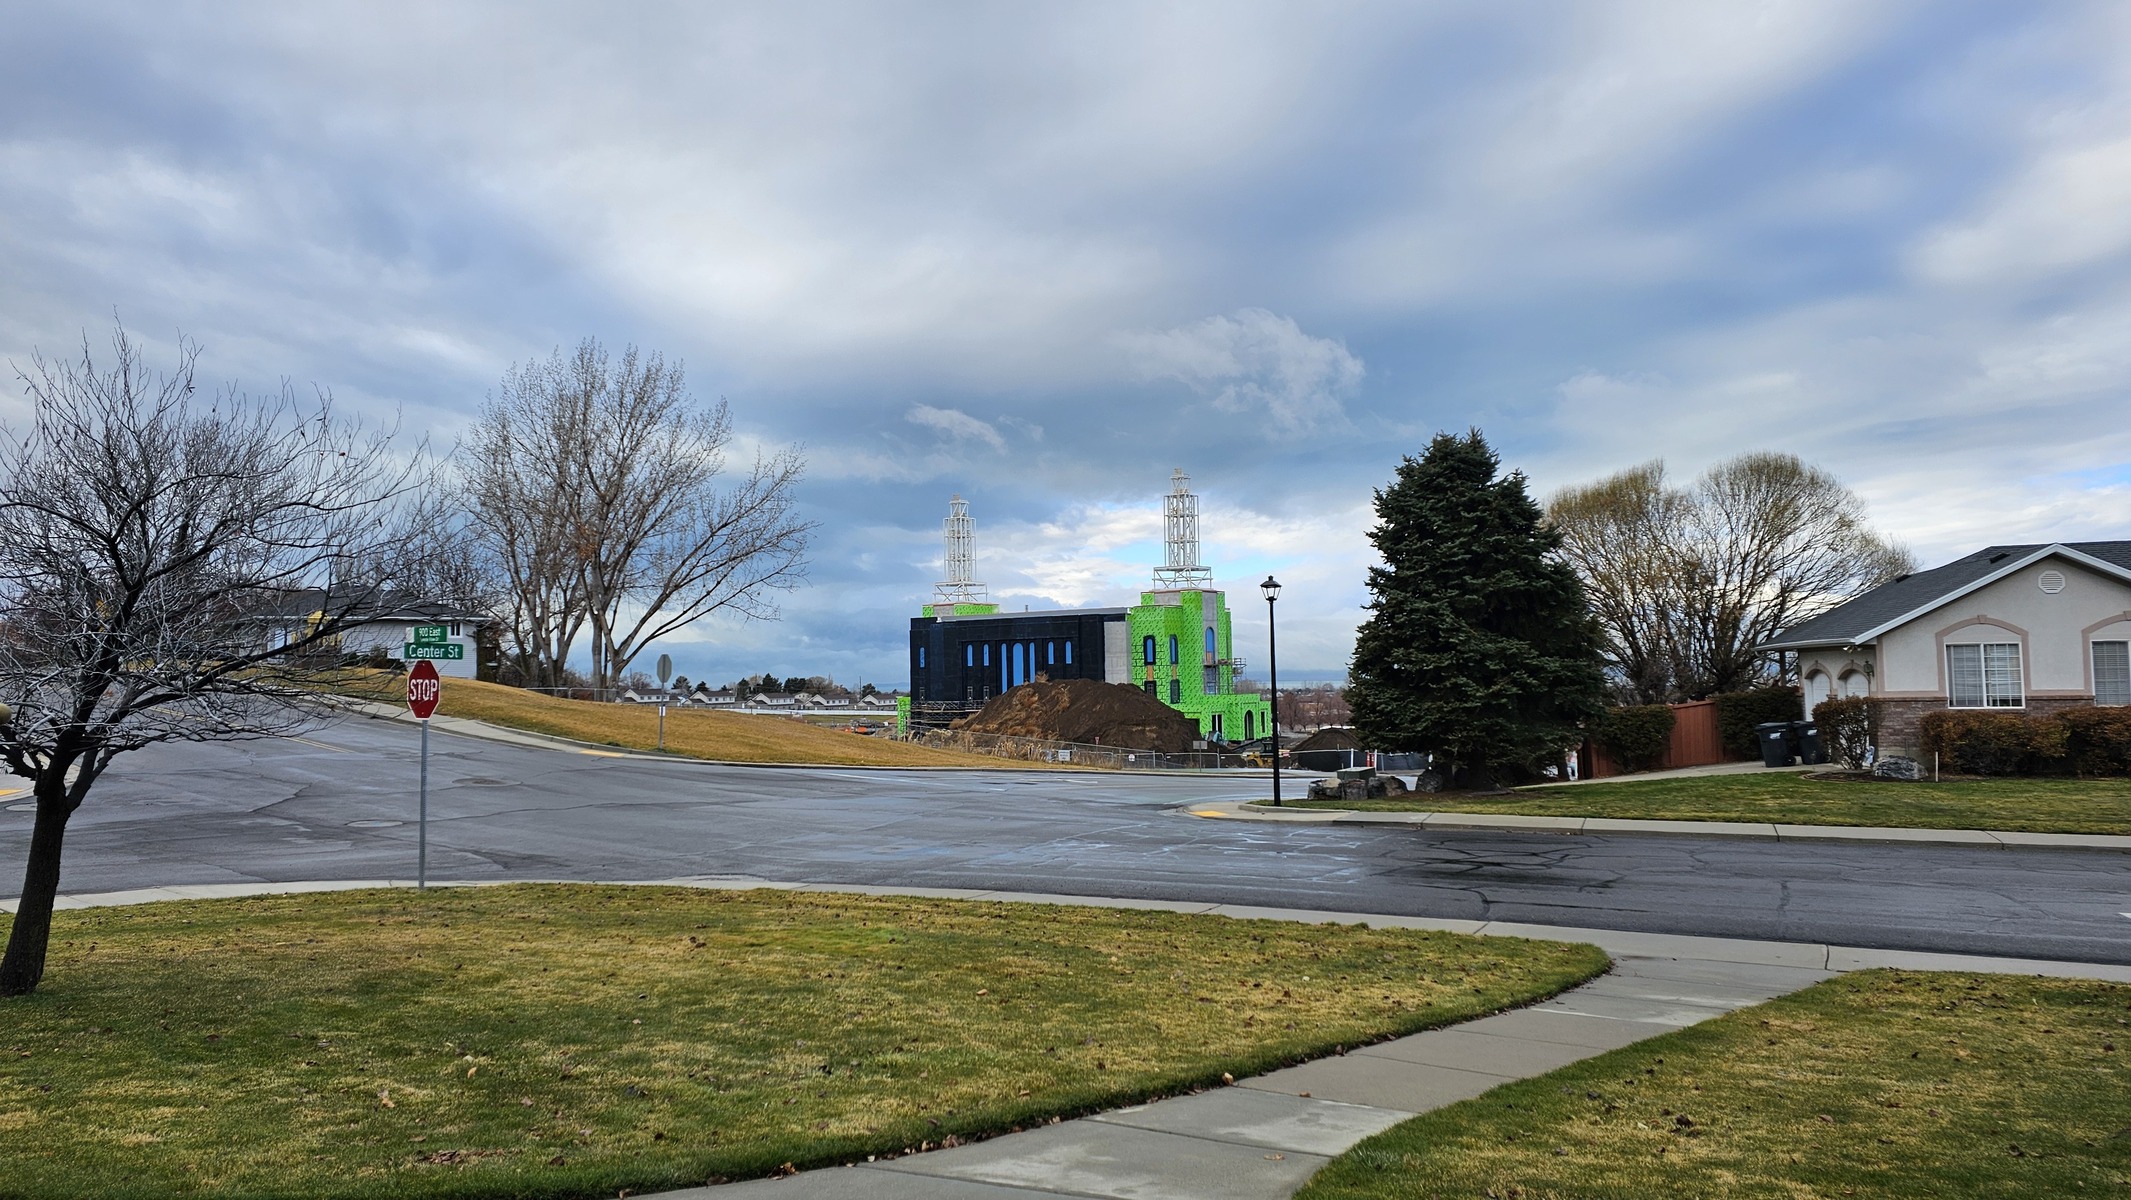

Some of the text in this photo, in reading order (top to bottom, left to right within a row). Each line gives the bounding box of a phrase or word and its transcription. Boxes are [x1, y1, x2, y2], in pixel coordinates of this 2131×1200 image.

[419, 627, 441, 637] 900 East
[409, 644, 459, 658] Center St
[409, 679, 438, 701] STOP
